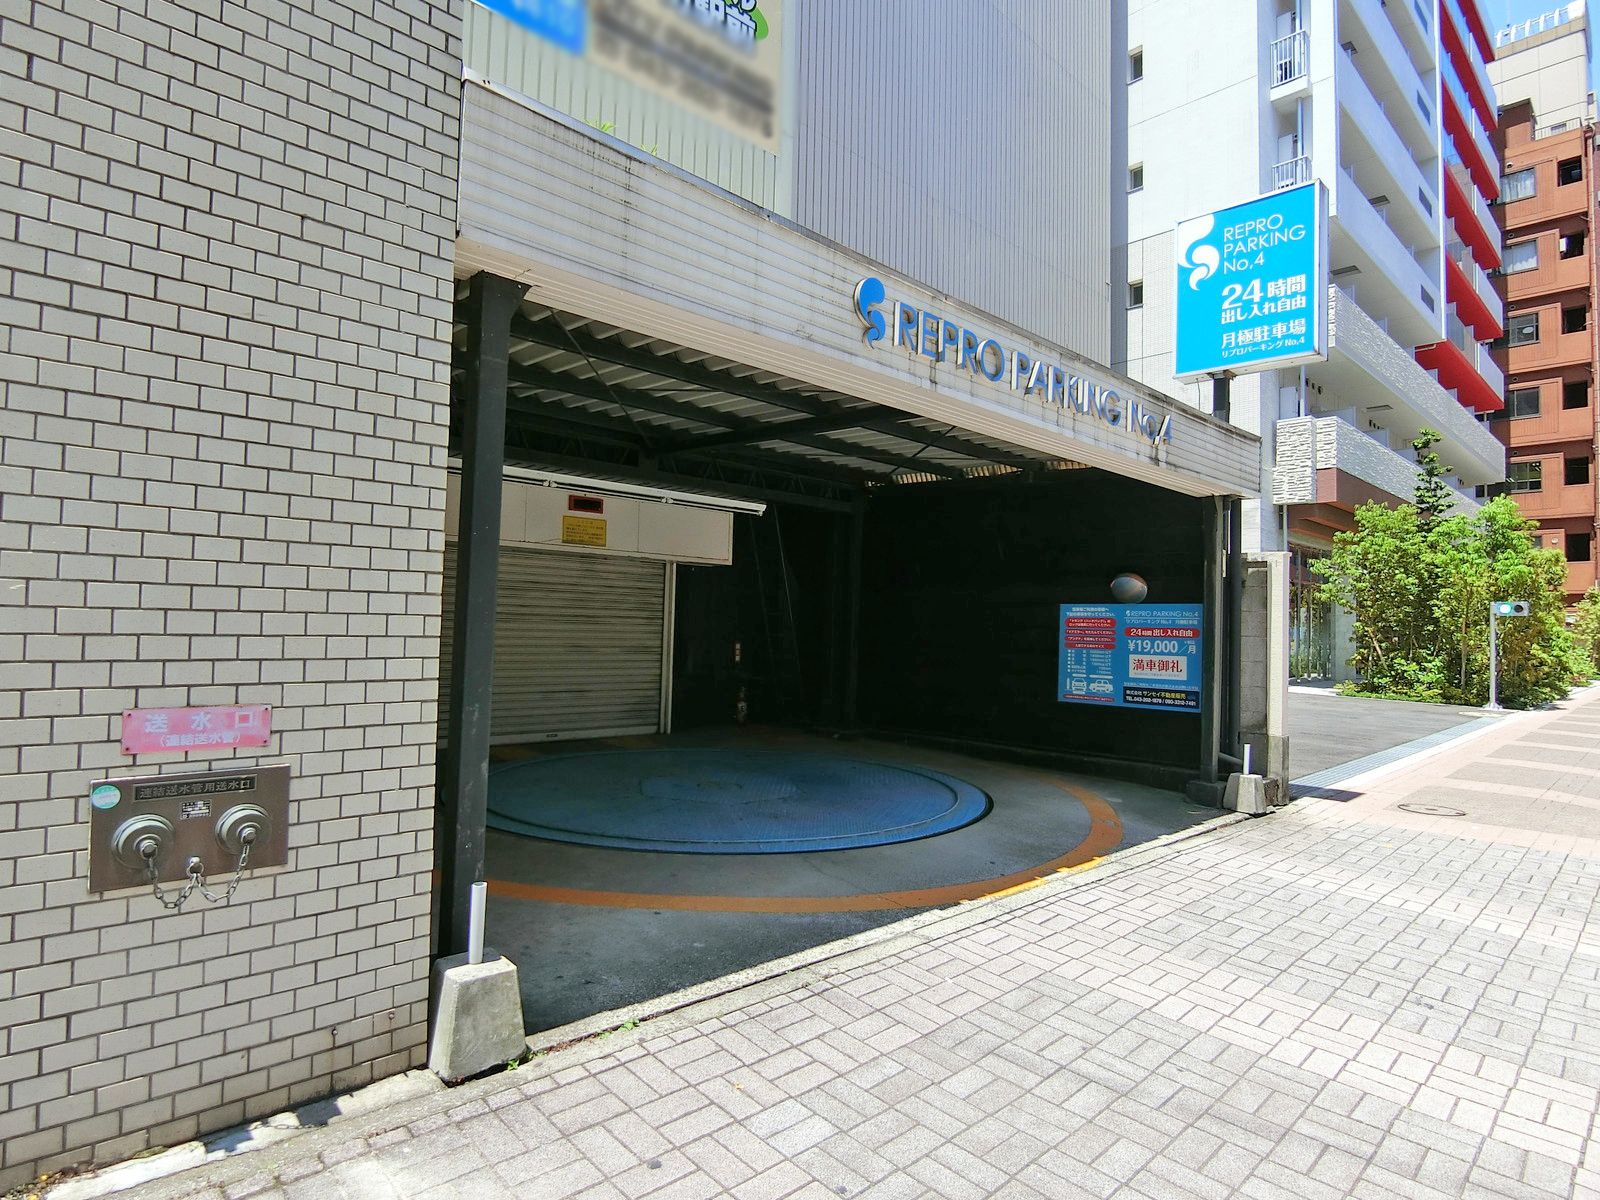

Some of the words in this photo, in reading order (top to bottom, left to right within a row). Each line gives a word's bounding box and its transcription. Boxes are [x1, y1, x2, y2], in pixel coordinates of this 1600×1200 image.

[1223, 214, 1283, 243] REPRO
[1223, 224, 1306, 259] PARKING
[1221, 294, 1307, 325] 出し入れ自由
[1221, 318, 1306, 350] 月極駐車場
[893, 300, 1006, 383] REPRO
[1010, 350, 1122, 427] PARKING
[1221, 340, 1284, 359] リプロパーキング
[1132, 658, 1183, 673] 満車御礼
[143, 711, 256, 734] 送水口
[140, 779, 251, 798] 連結送水管用送水口
